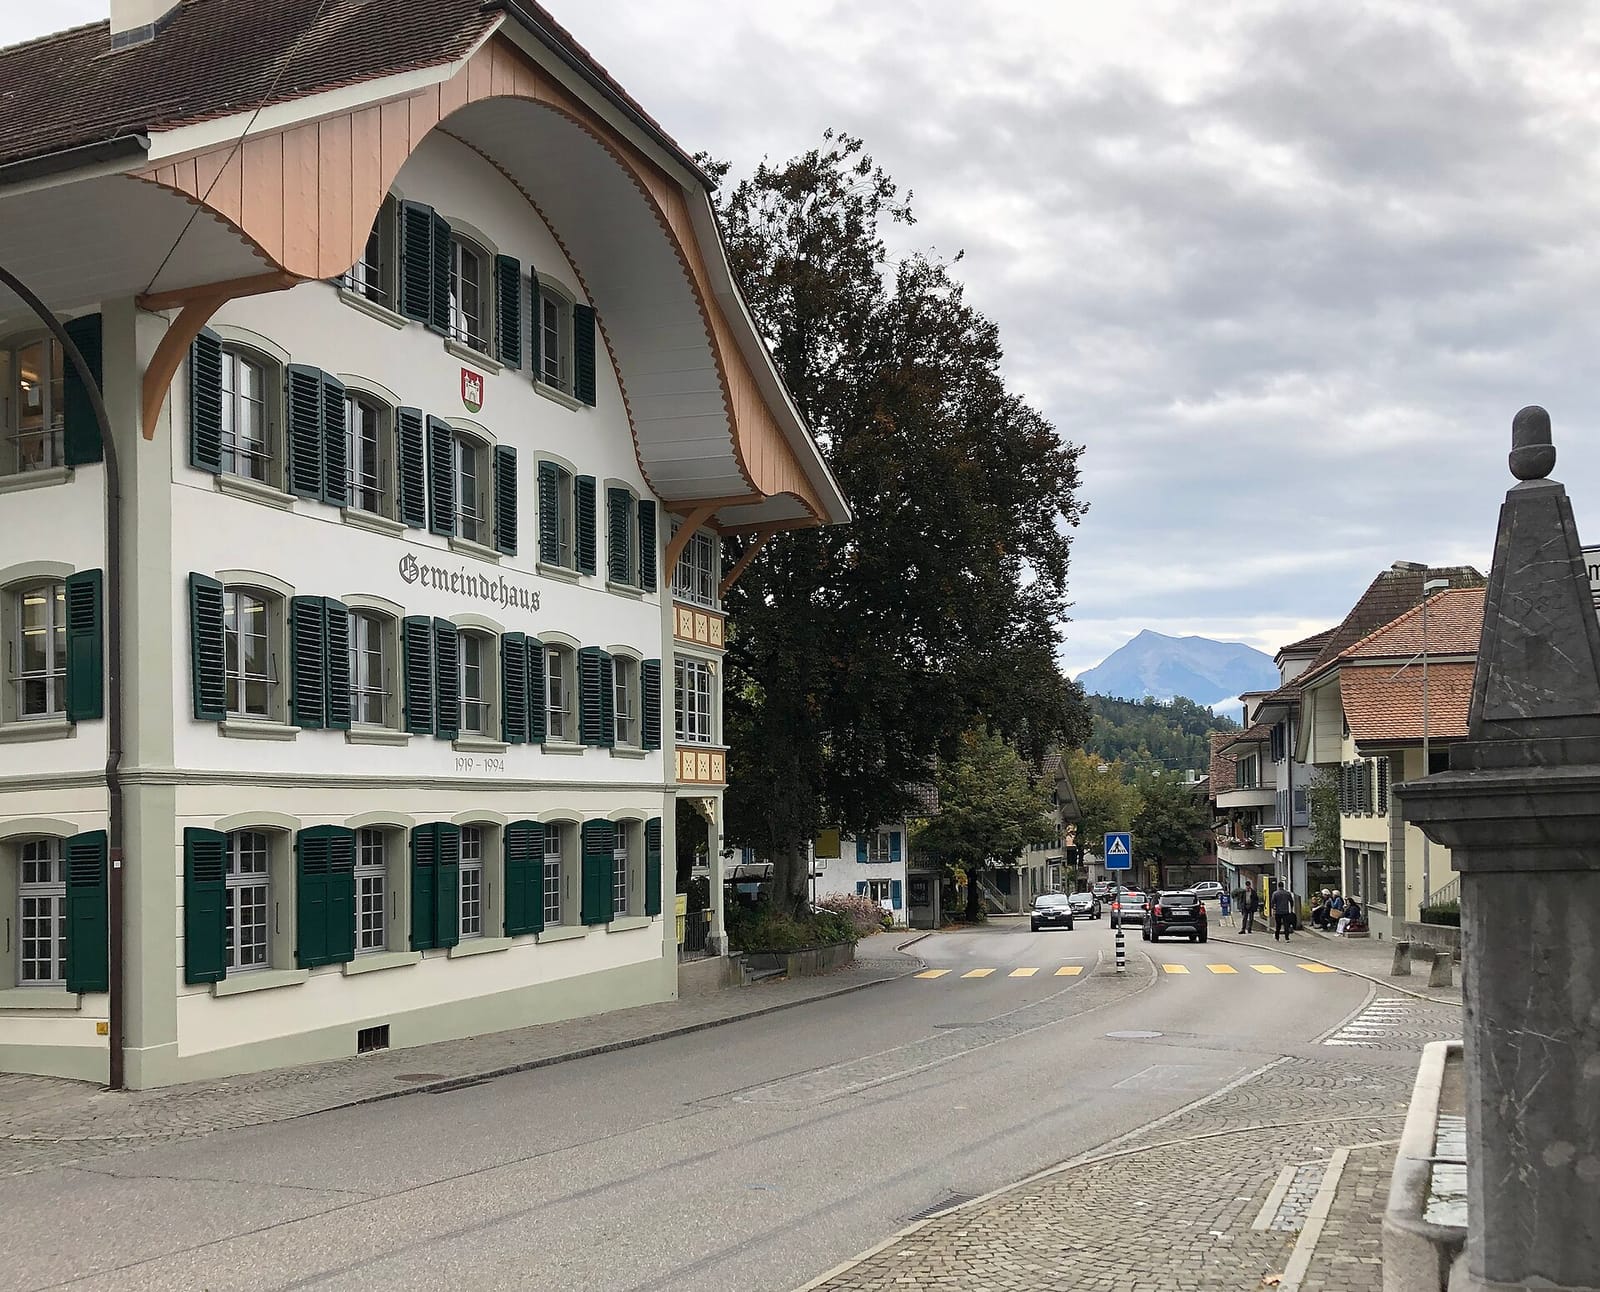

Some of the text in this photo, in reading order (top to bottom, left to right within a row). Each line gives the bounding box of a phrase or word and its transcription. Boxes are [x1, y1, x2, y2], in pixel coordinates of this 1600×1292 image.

[399, 553, 541, 612] Gemeindehaus
[455, 757, 474, 771] 1919
[484, 758, 505, 772] 1994
